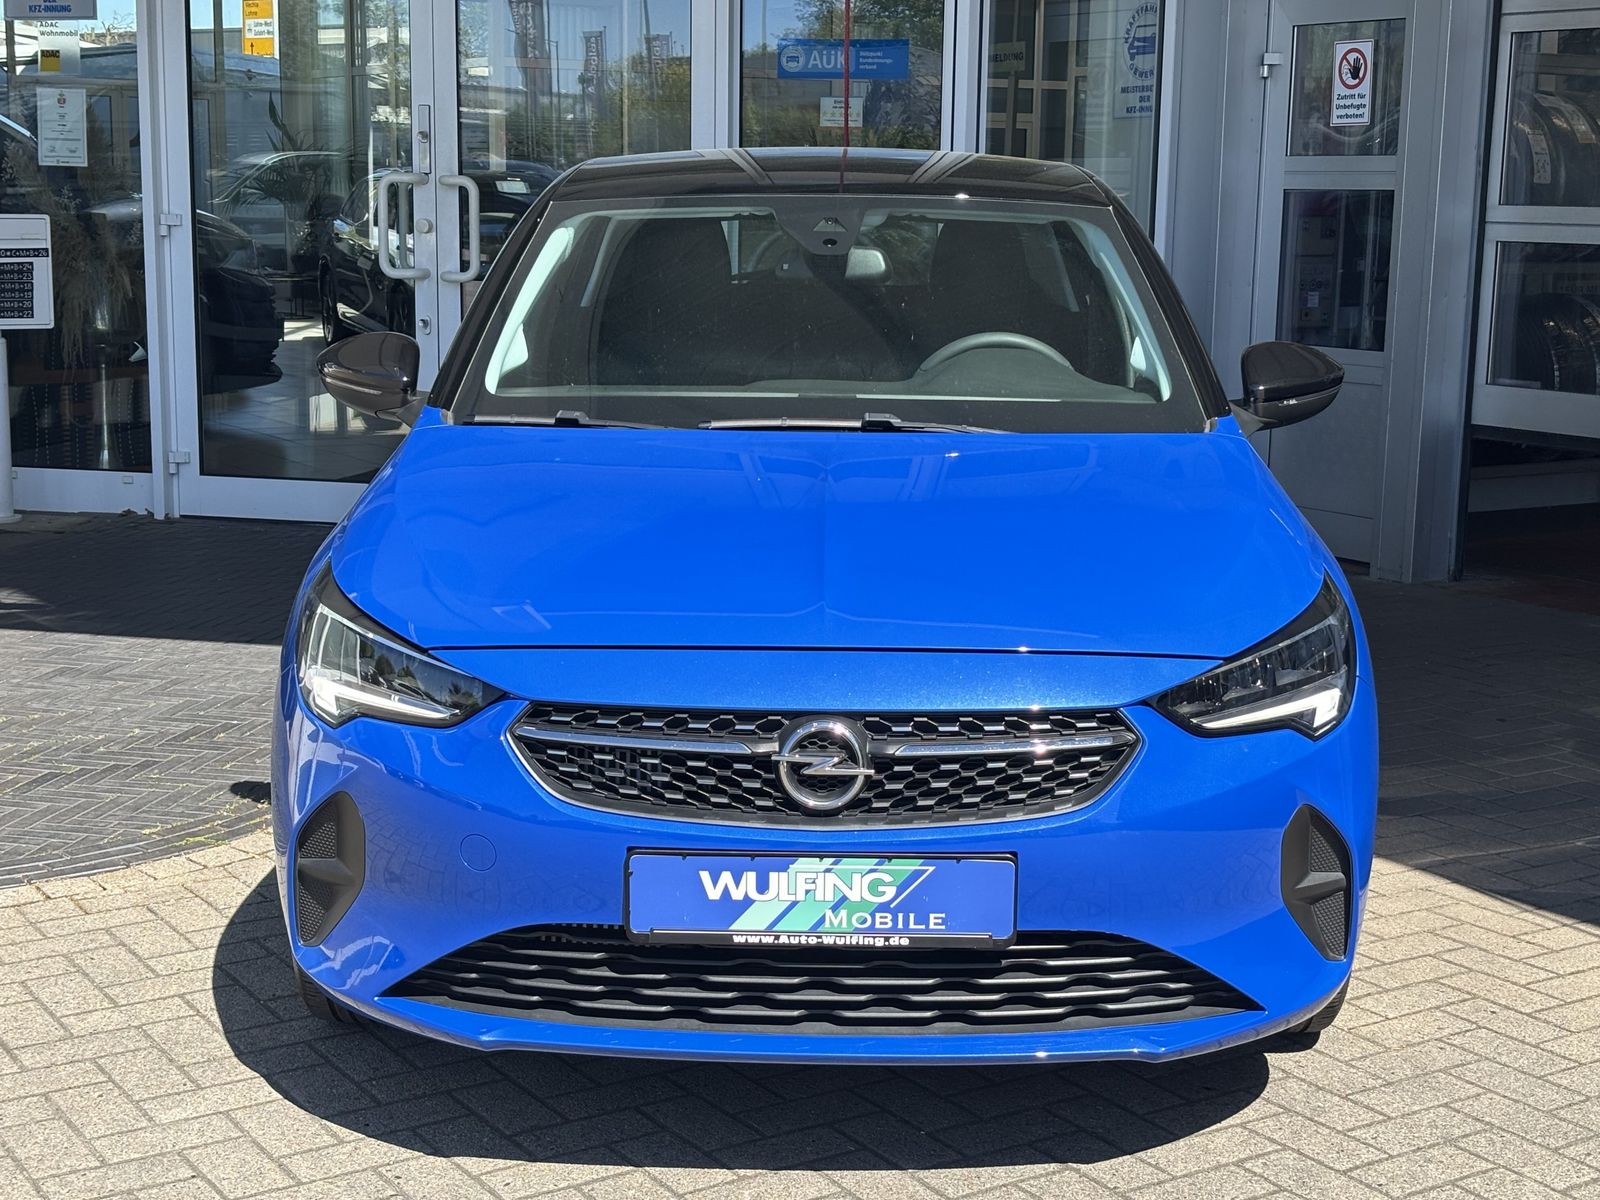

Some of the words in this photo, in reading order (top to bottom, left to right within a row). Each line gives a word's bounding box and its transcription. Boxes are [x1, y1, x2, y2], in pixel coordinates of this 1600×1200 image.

[28, 4, 72, 13] KFZ-INNUNG
[39, 29, 79, 37] Wohnmobil
[41, 50, 60, 58] ADAC
[1138, 95, 1151, 104] DER
[698, 870, 898, 904] WULFING
[824, 909, 947, 930] MOBILE
[732, 934, 910, 946] www.Auto-Wulfing.de
